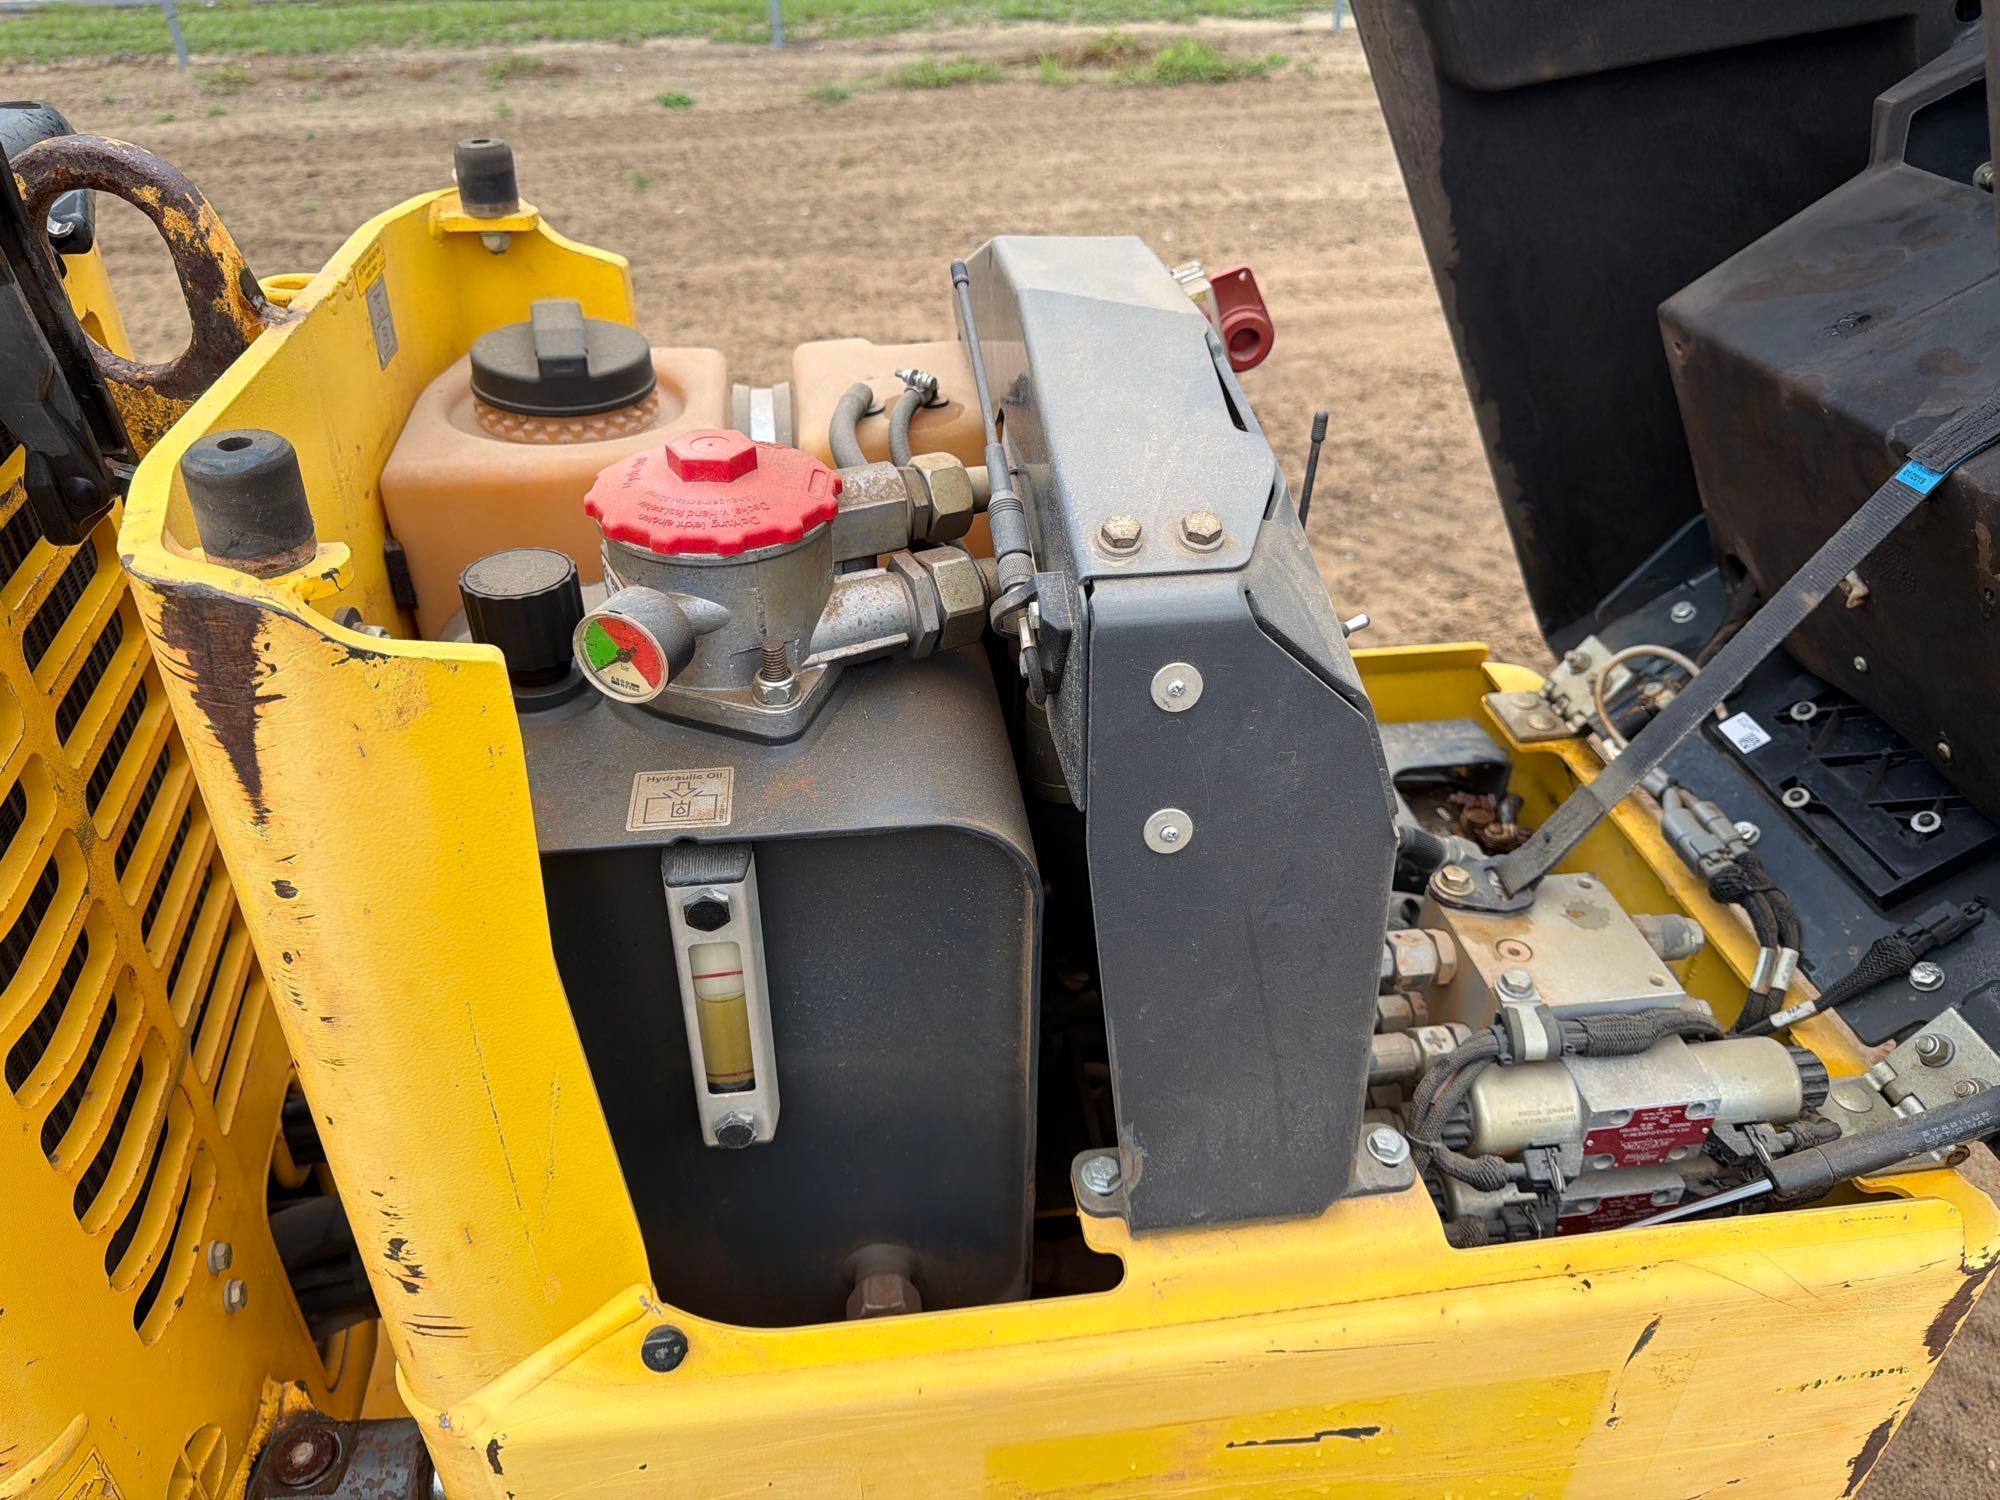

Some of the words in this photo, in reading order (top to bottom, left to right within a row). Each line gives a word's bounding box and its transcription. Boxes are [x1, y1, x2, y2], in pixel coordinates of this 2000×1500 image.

[686, 509, 718, 521] Hand
[675, 521, 707, 531] leicht
[646, 774, 703, 783] Hydraulic
[1921, 1111, 1990, 1137] STABILUS
